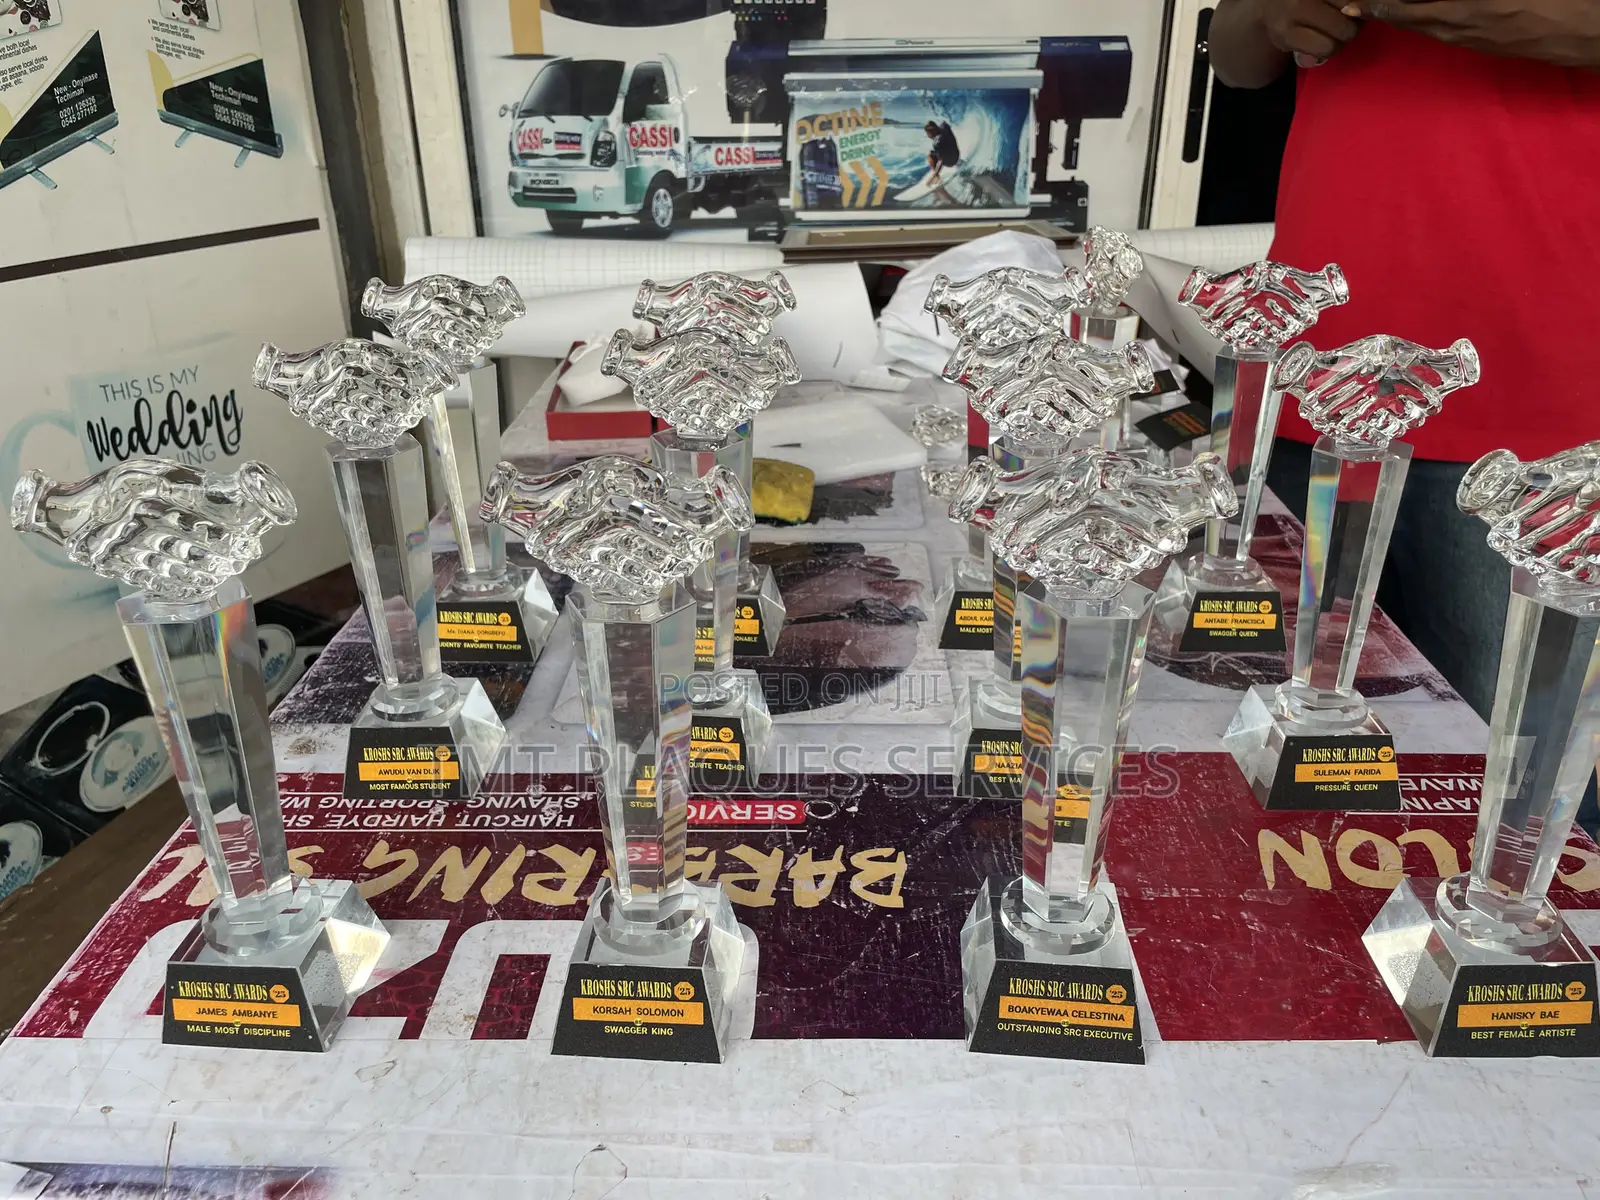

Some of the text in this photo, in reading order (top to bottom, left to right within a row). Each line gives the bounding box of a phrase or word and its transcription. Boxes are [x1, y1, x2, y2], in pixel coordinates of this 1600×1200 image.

[18, 39, 31, 48] local
[0, 49, 21, 60] ntinental
[22, 60, 34, 69] local
[53, 84, 68, 96] New
[71, 72, 99, 88] Onyinase
[209, 81, 223, 93] New
[55, 88, 85, 105] Techiman
[59, 106, 74, 119] 0201
[61, 104, 98, 128] 0545 277192
[517, 127, 544, 153] CASSI
[629, 124, 673, 148] CASSI
[840, 128, 882, 149] ENERGY
[714, 146, 756, 167] CASSI
[841, 144, 876, 163] DRINK
[99, 365, 200, 403] THIS IS MY
[86, 389, 243, 463] Wedding
[1223, 600, 1235, 612] SRC
[1235, 600, 1258, 613] AWARDS
[463, 611, 475, 624] SRC
[474, 611, 498, 625] AWARDS
[463, 642, 494, 650] FAVOURITE
[496, 643, 522, 651] TEACHER
[691, 726, 718, 741] AWARDS
[363, 747, 391, 761] KROSHS
[391, 747, 406, 761] SRC
[406, 746, 434, 761] AWARDS
[981, 740, 1010, 754] KROSHS
[1302, 748, 1332, 762] KROSHS
[1331, 748, 1347, 762] SRC
[1347, 747, 1377, 761] AWARDS
[378, 768, 405, 776] AWUDU
[689, 762, 745, 771] OURITE TEACHER
[1313, 768, 1381, 777] SULEMAN FARIDA
[369, 783, 389, 791] MOST
[419, 782, 451, 790] STUDENT
[1009, 776, 1023, 784] MA
[1315, 783, 1378, 792] PRESSURE QUEEN
[465, 796, 581, 810] SHAVING
[324, 812, 447, 828] HAIRDYE,
[454, 812, 575, 828] HAIRCUT,
[178, 980, 213, 998] KROSHS
[214, 982, 232, 1000] SRC
[233, 983, 268, 1001] AWARDS
[580, 978, 616, 997] KROSHS
[617, 980, 635, 997] SRC
[636, 981, 672, 999] AWARDS
[1009, 977, 1046, 997] KROSHS
[1046, 980, 1065, 998] SRC
[1066, 982, 1104, 1001] AWARDS
[1467, 984, 1506, 1002] KROSHS
[1506, 984, 1525, 1001] SRC
[1525, 982, 1563, 1001] AWARDS
[195, 1007, 278, 1019] JAMES AMBANYE
[592, 1005, 684, 1017] KORSAH SOLOMON
[1007, 1004, 1126, 1022] BOAKYEWAA CELESTINA
[1491, 1010, 1560, 1021] HANISKY BAE
[187, 1024, 291, 1038] MALE MOST DISCIPLINE
[604, 1025, 674, 1036] SWAGGER KING
[997, 1022, 1134, 1041] OUTSTANDING SRC EXECUTIVE
[1471, 1028, 1577, 1040] BEST FEMALE ARTISTE
